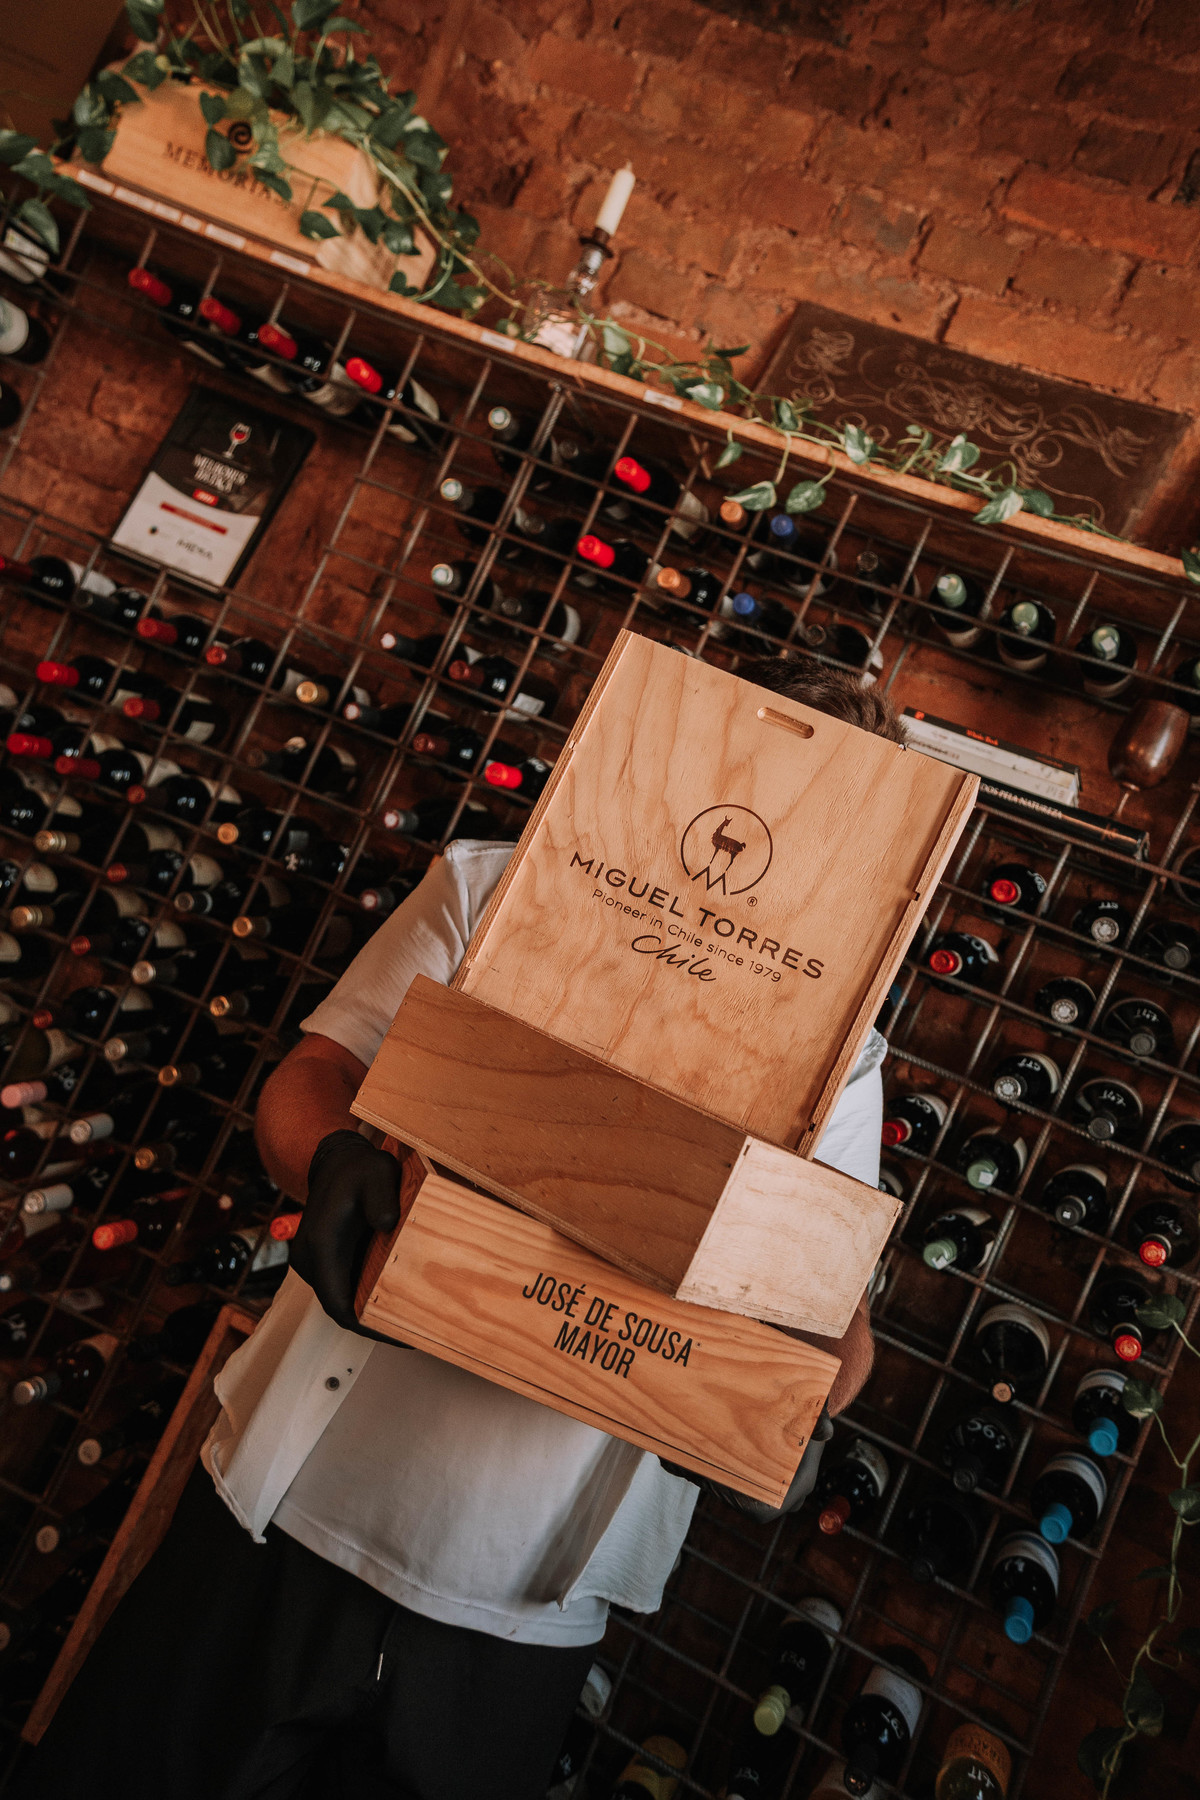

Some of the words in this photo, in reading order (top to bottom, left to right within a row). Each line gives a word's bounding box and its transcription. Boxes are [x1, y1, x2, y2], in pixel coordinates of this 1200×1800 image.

[569, 851, 684, 918] MIGUEL
[698, 907, 825, 980] TORRES
[592, 888, 647, 920] Pioneer
[649, 915, 663, 930] in
[667, 924, 703, 948] Chile
[706, 940, 744, 966] since
[749, 960, 781, 983] 1979
[631, 934, 717, 982] Chile
[522, 1272, 586, 1318] JOSÉ
[583, 1296, 619, 1333] DE
[618, 1312, 693, 1368] SOUSA
[553, 1320, 636, 1379] MAYOR
